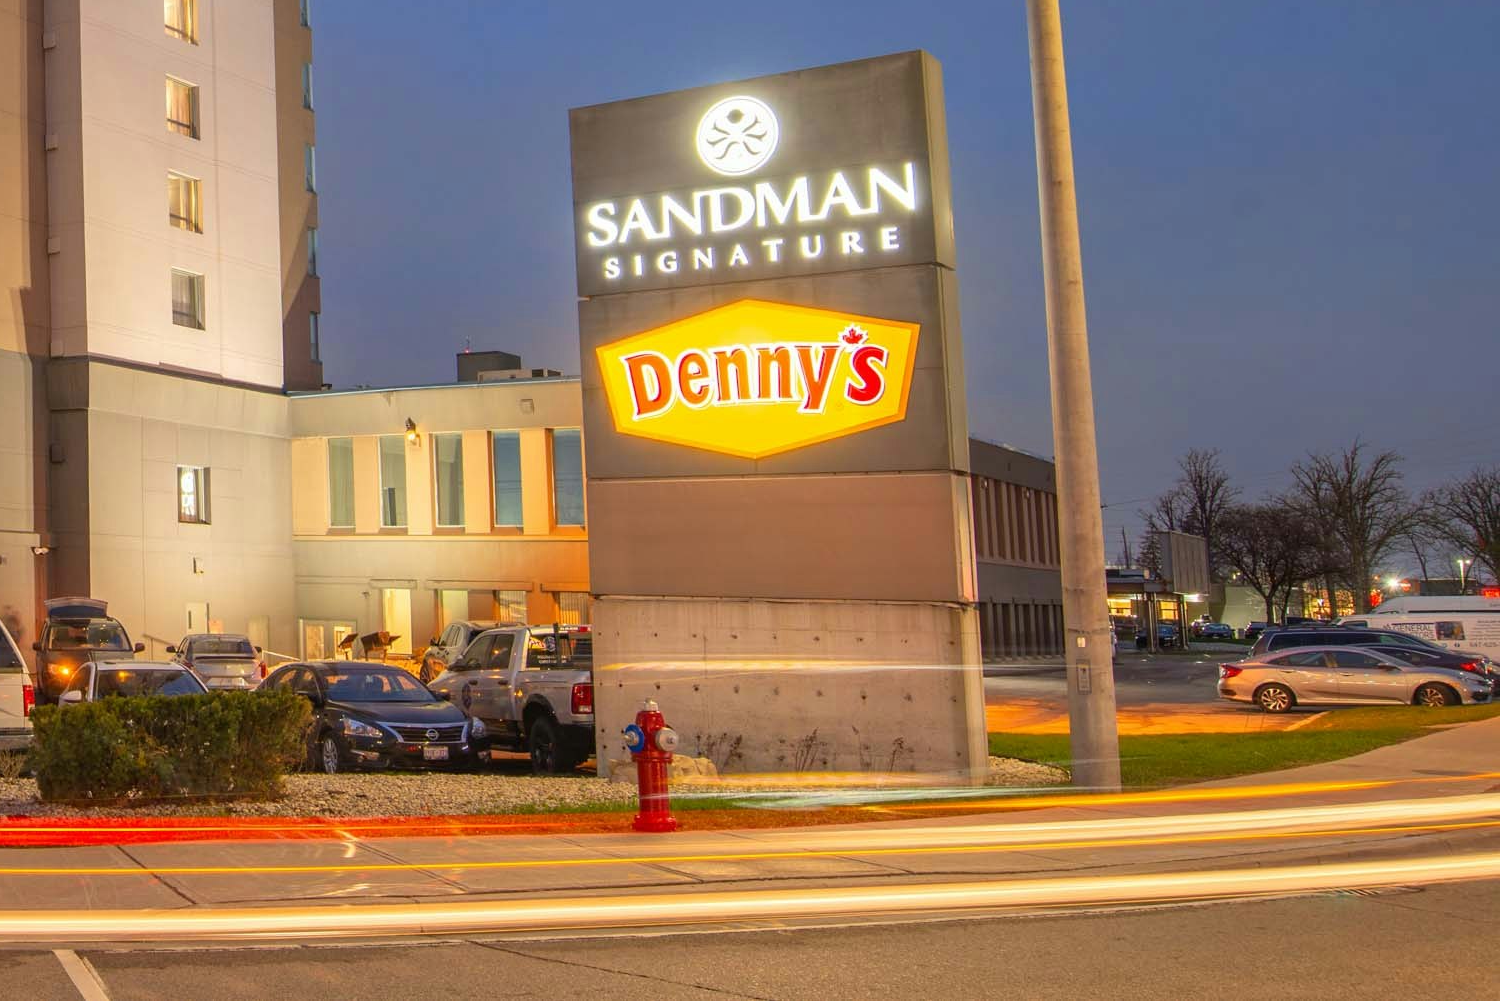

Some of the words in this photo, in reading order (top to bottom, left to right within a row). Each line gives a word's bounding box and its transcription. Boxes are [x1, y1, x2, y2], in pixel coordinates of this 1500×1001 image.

[587, 162, 916, 248] SANDMAN
[604, 227, 899, 279] SIGNATURE
[621, 325, 889, 420] Denny's
